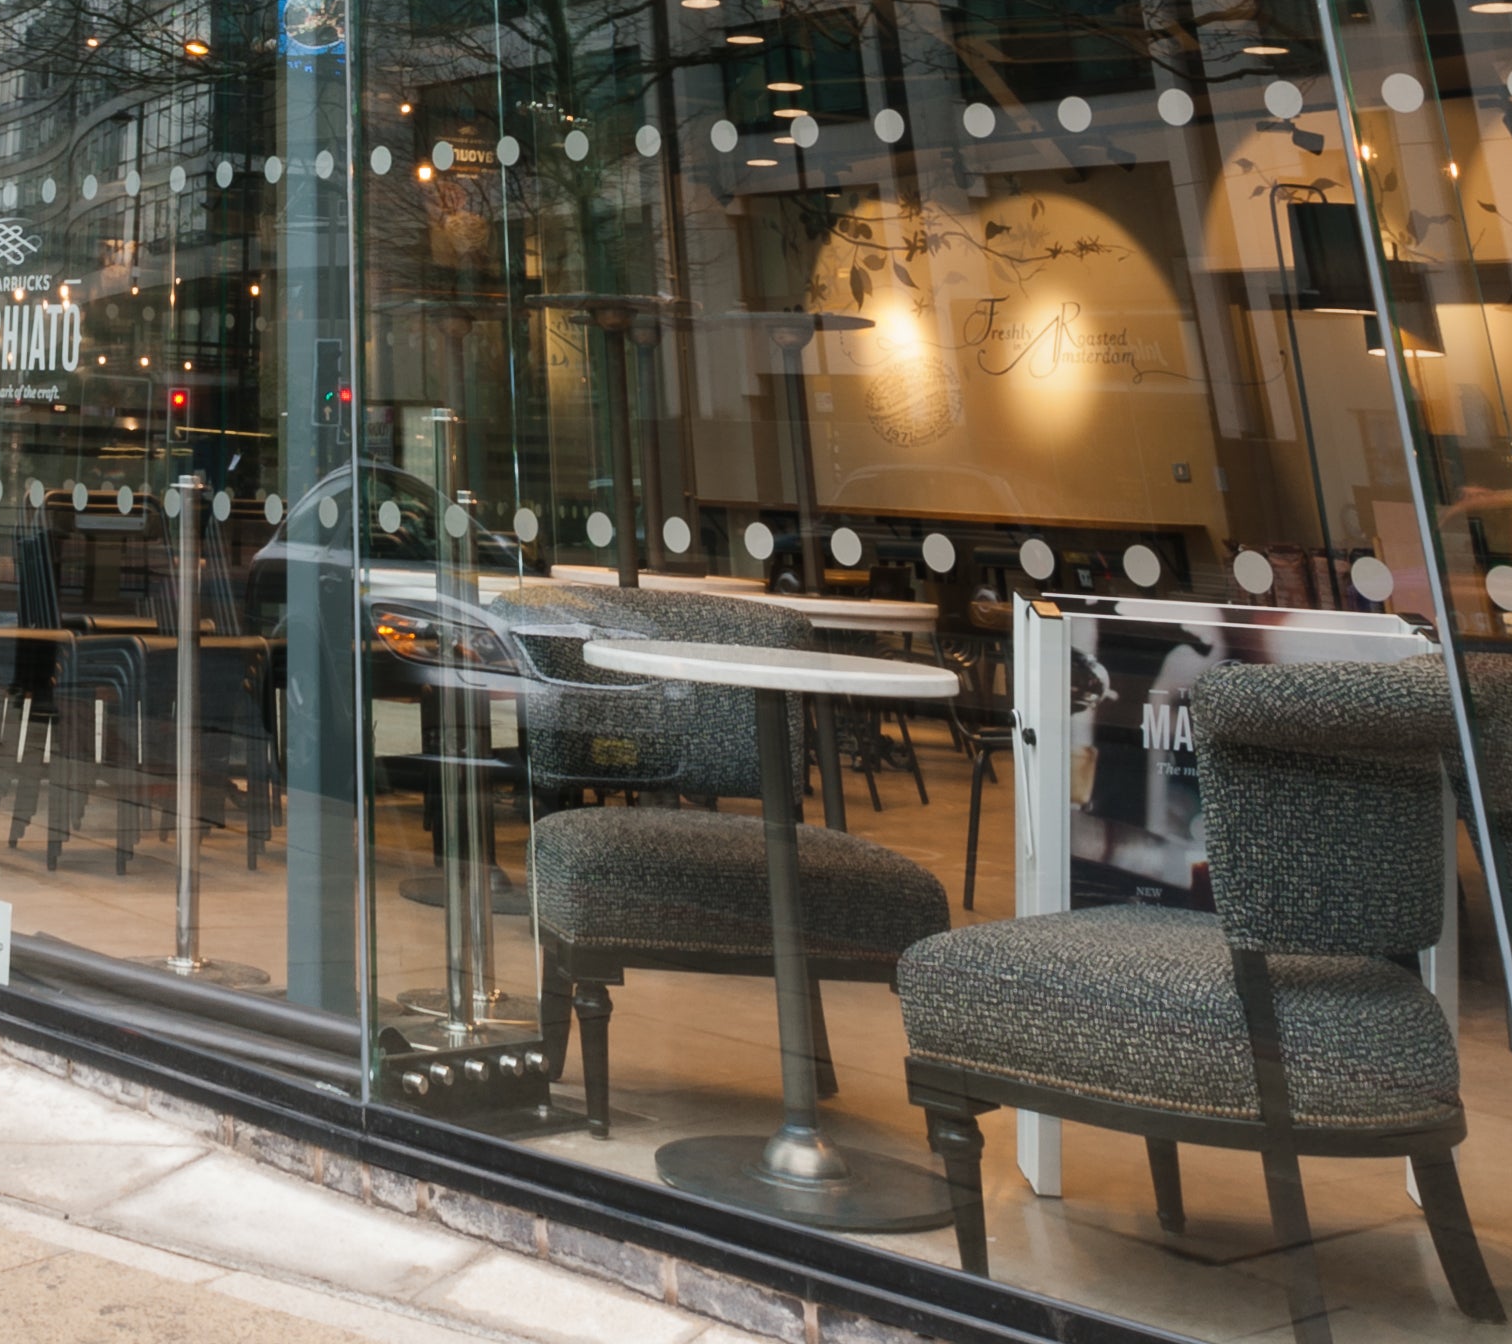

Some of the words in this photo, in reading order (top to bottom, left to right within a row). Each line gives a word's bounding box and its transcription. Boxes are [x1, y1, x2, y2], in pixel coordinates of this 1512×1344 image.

[964, 295, 1032, 347] Freshly
[1060, 300, 1128, 349] Roasted
[14, 384, 24, 401] of
[23, 384, 36, 399] the
[36, 384, 60, 402] craft.
[885, 426, 914, 444] 1971
